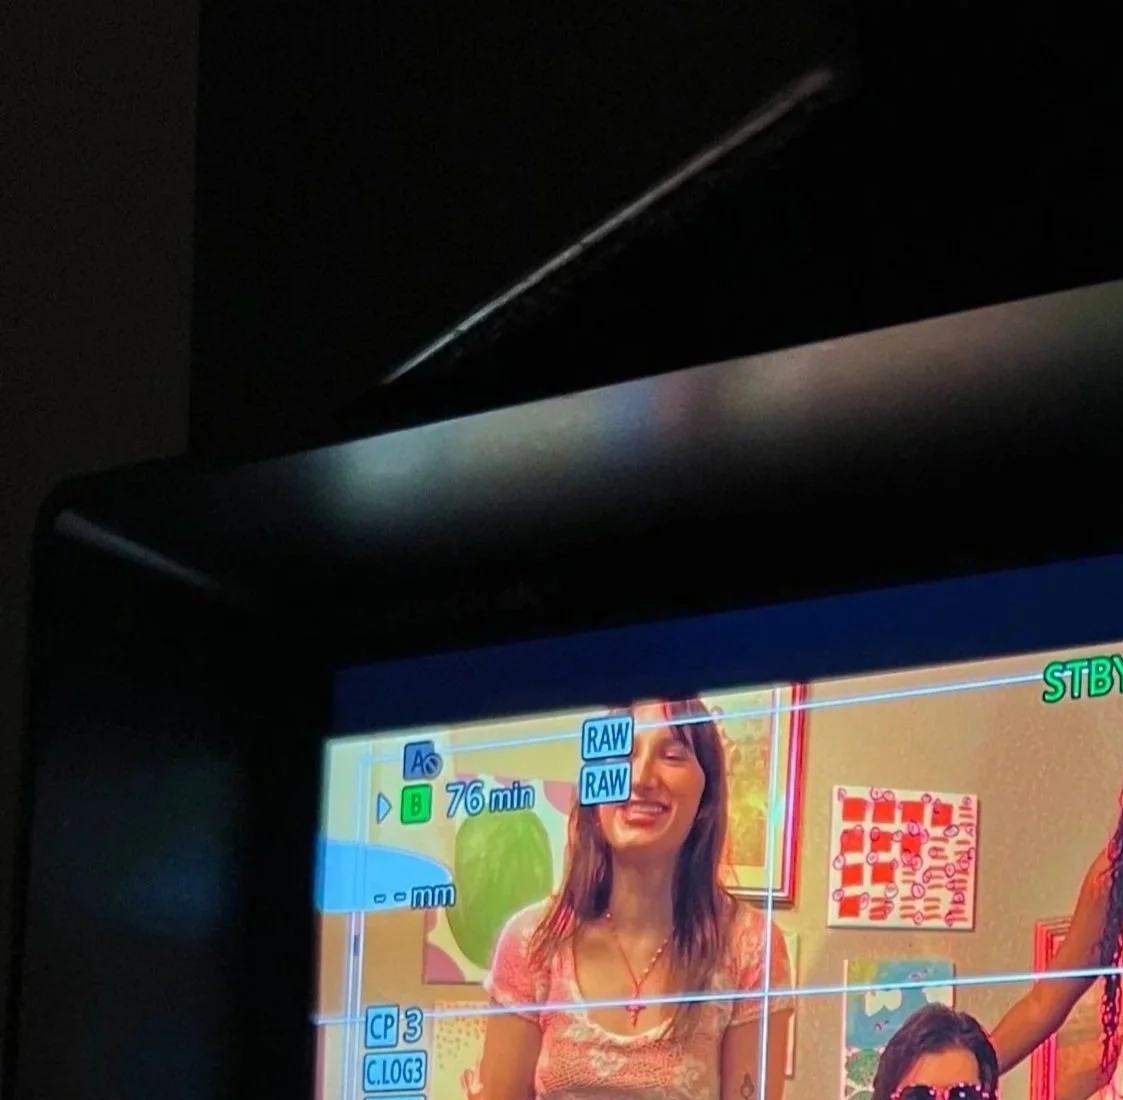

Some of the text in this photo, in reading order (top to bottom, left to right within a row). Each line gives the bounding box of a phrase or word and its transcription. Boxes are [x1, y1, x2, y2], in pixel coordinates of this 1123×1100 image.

[587, 722, 630, 755] RAW
[410, 780, 536, 819] B 76 min
[584, 768, 628, 799] RAW
[369, 1006, 424, 1043] CP 3
[366, 1058, 424, 1087] C.LOG3
